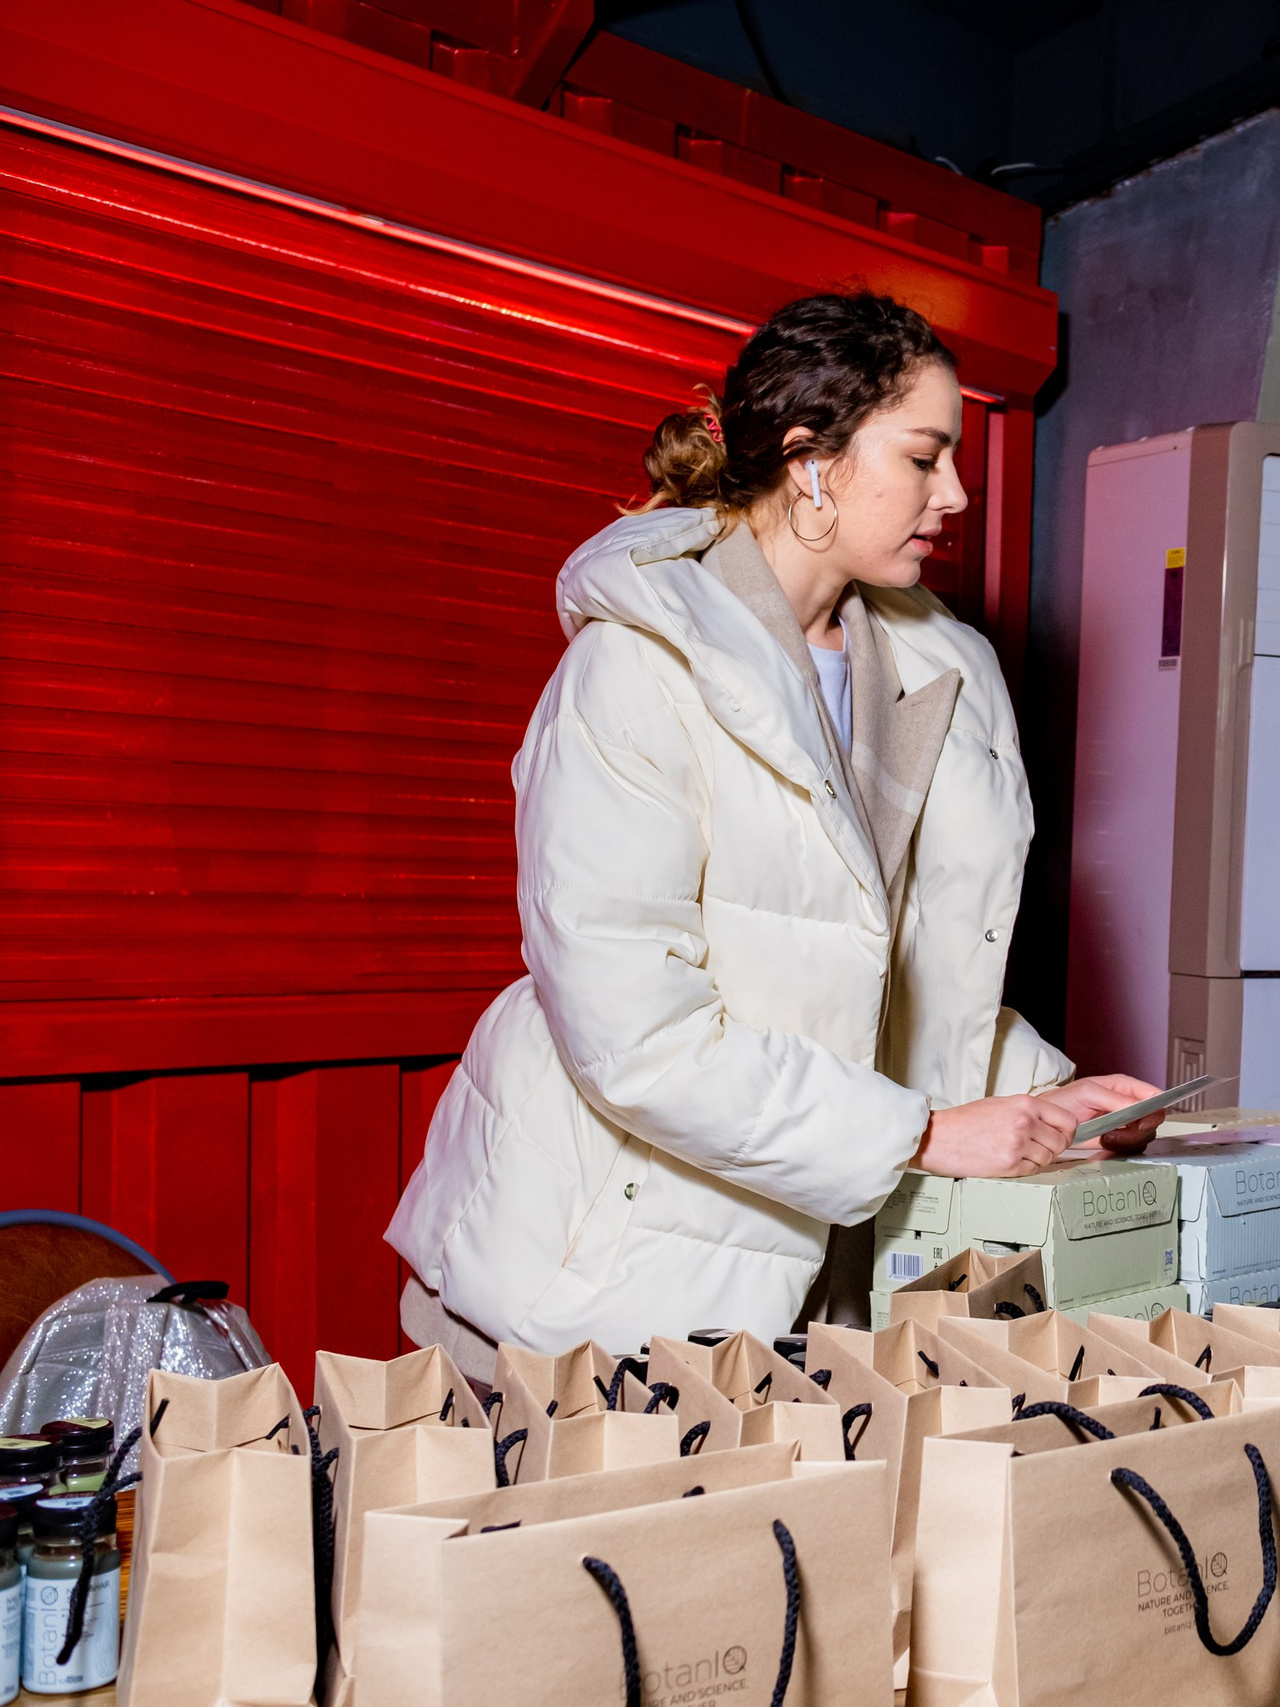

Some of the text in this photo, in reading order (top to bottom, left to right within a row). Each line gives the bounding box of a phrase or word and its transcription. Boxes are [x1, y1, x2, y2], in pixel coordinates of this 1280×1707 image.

[1083, 1180, 1158, 1217] BotanIQ
[1138, 1593, 1172, 1612] NATURE
[1173, 1590, 1192, 1604] AND
[1163, 1604, 1196, 1618] TOGETH
[620, 1645, 748, 1701] otanIQ
[669, 1690, 697, 1706] AND
